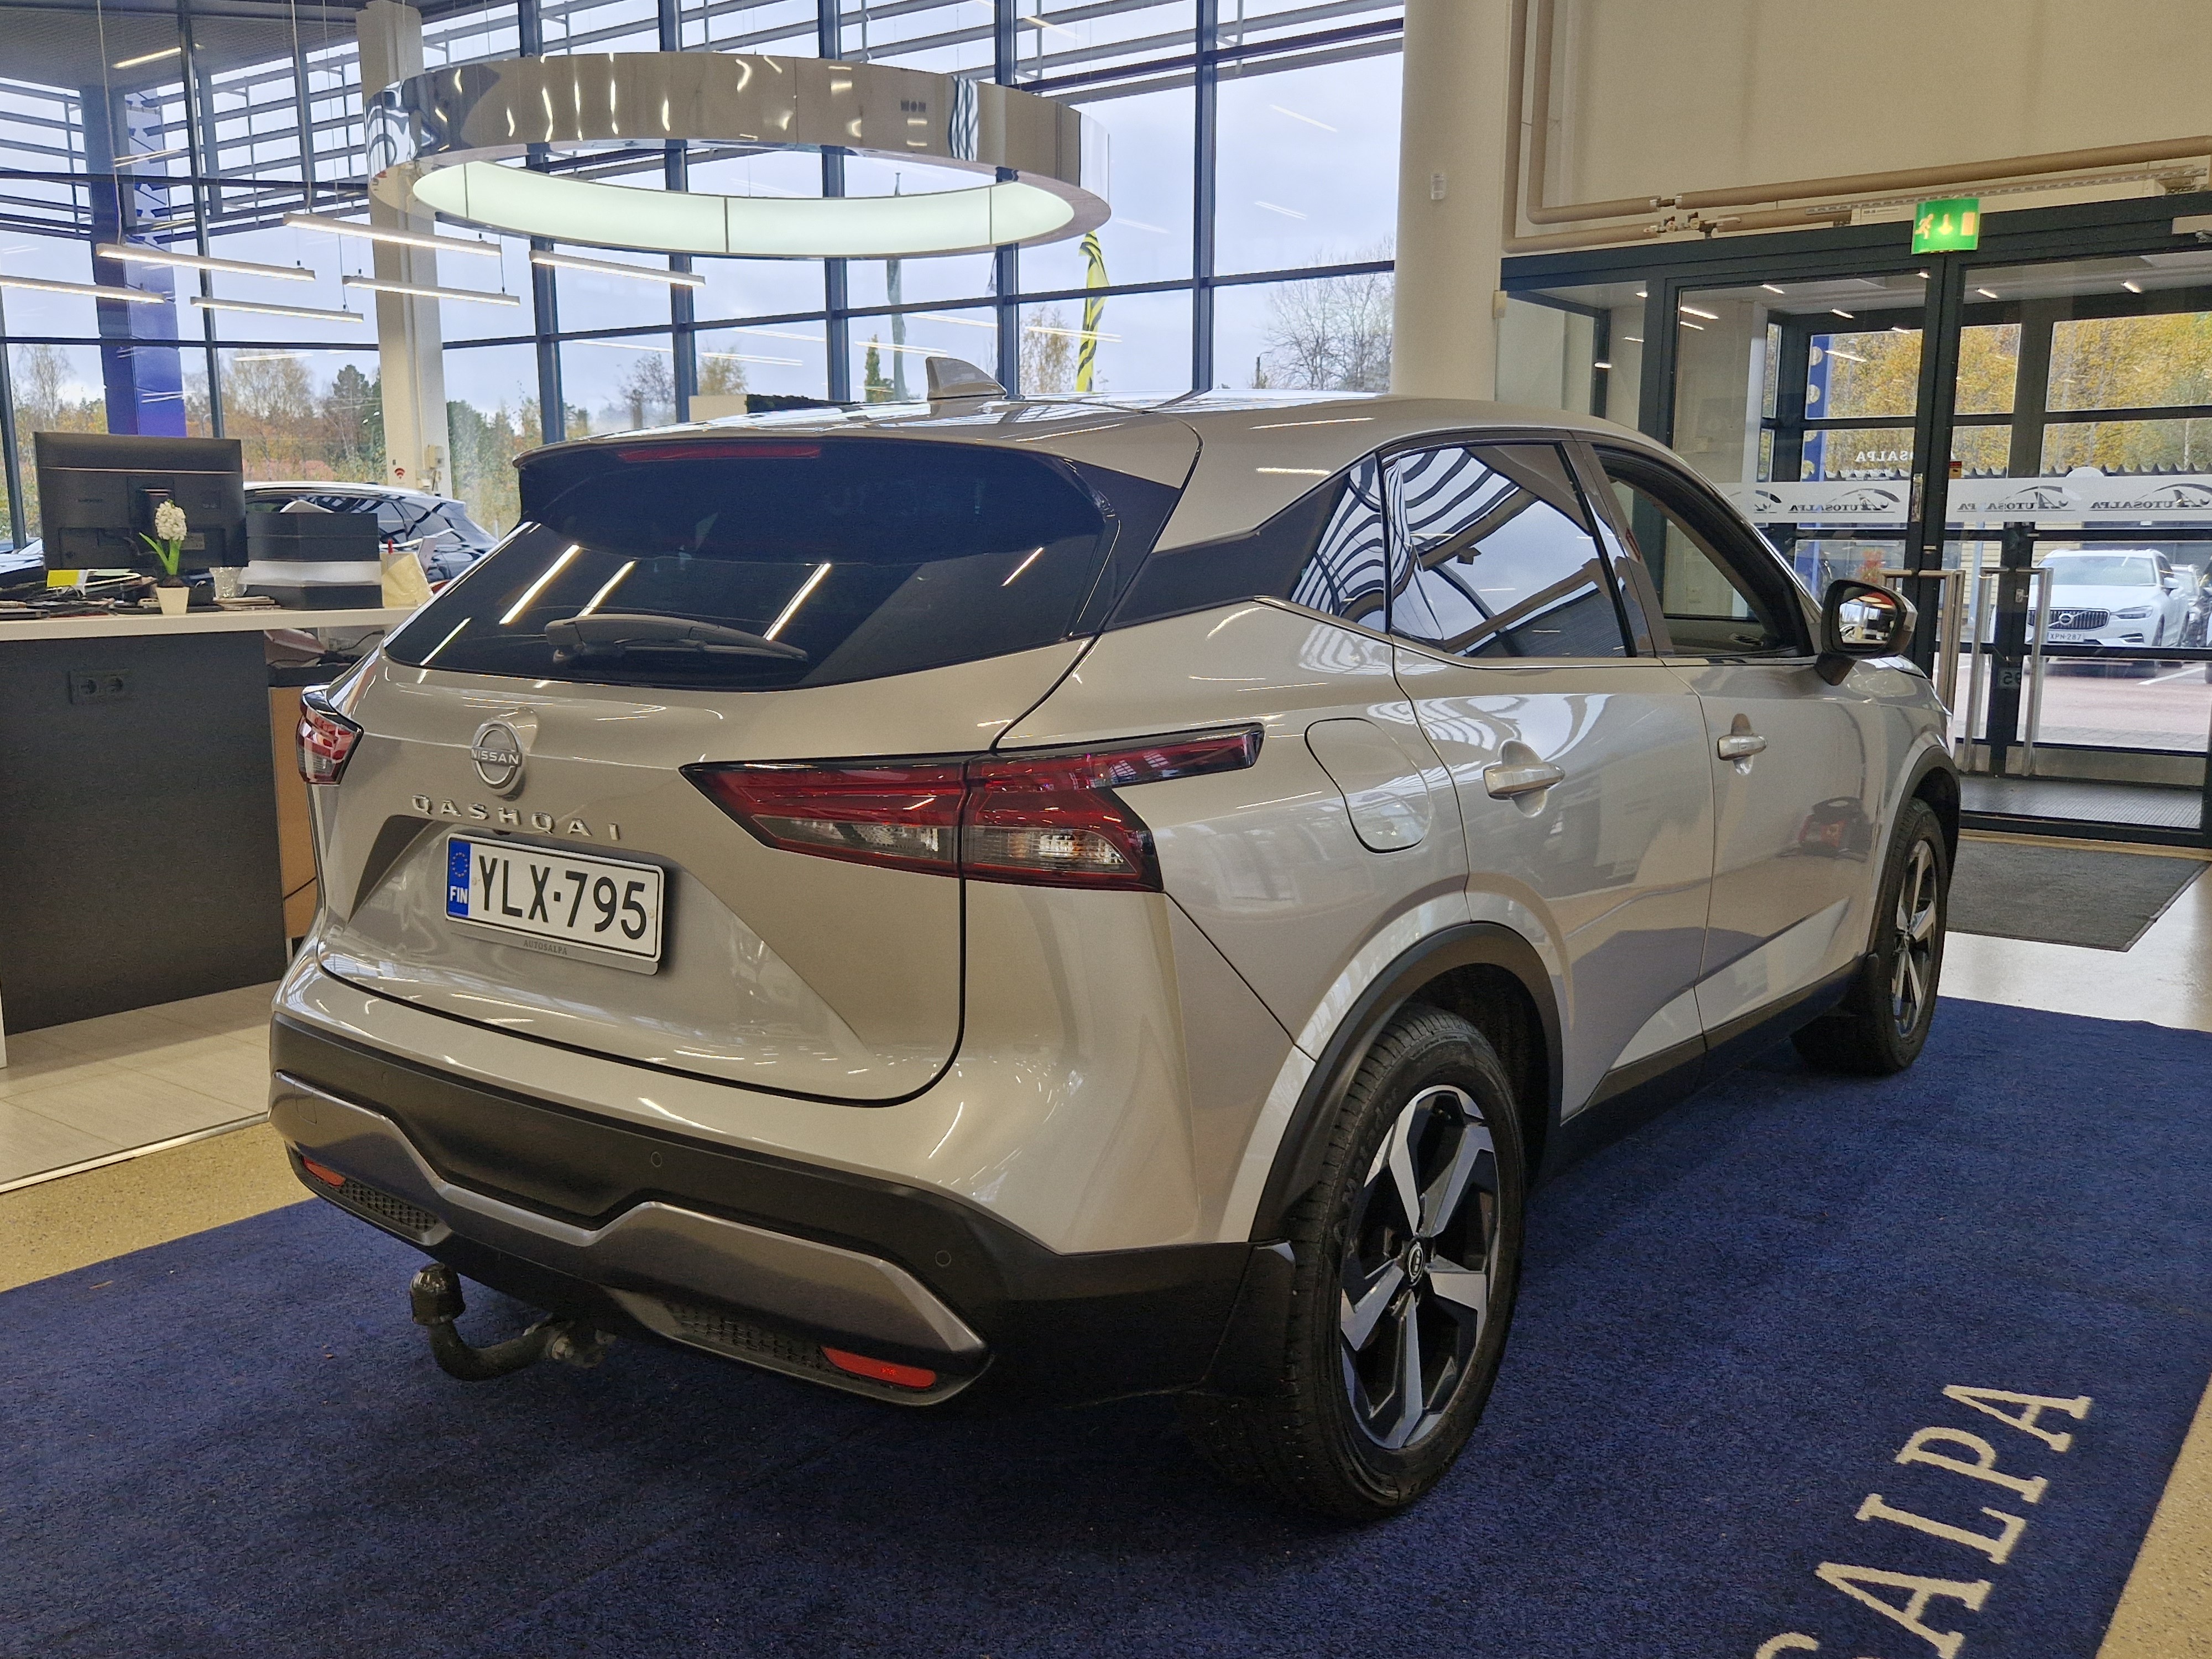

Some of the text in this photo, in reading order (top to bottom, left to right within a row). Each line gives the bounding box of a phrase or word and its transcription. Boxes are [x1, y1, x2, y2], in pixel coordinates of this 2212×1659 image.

[471, 749, 520, 764] NISSAN
[411, 794, 620, 841] QASHQAI
[450, 885, 468, 904] FIN
[523, 940, 568, 956] AUTOSALPA
